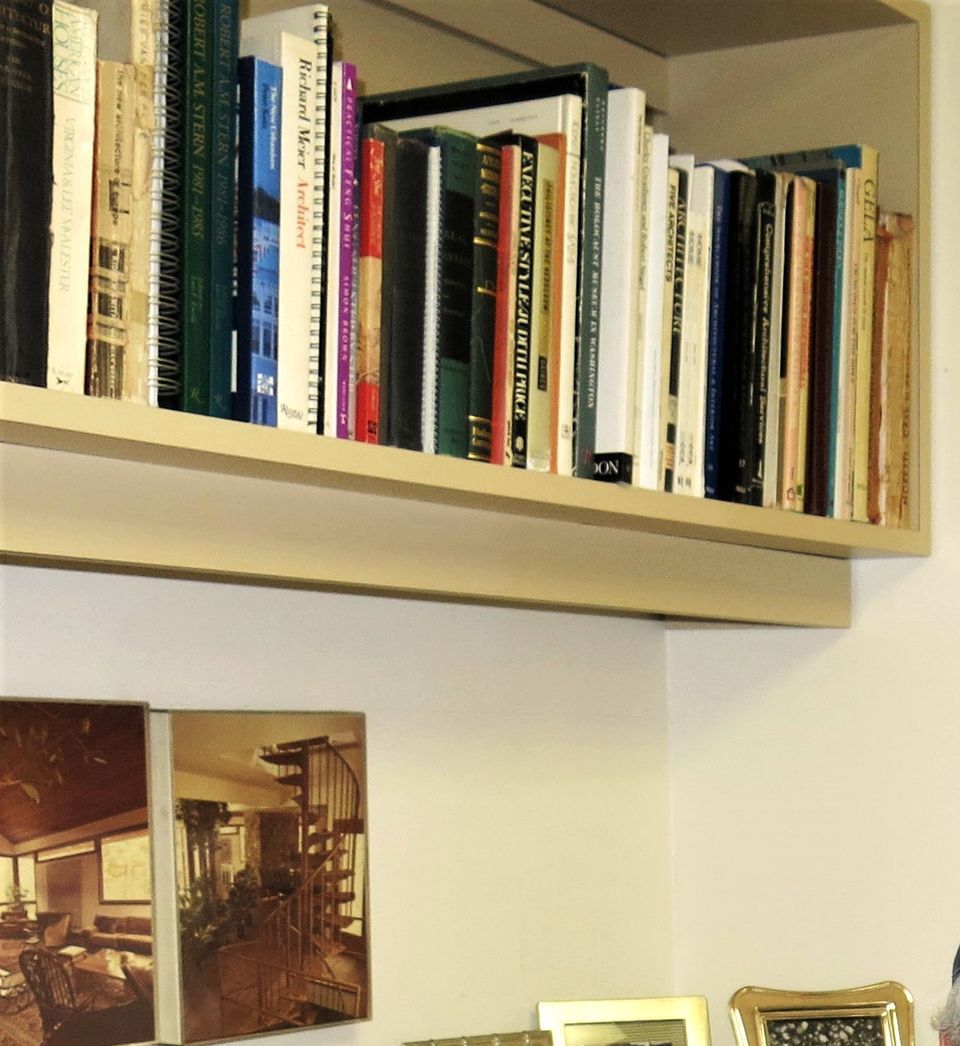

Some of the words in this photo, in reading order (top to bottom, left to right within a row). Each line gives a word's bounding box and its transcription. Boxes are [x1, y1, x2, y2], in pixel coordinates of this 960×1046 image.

[298, 58, 313, 122] Richard
[192, 104, 206, 156] STERN
[297, 126, 312, 170] Meier
[344, 95, 354, 163] PRACTICAL
[296, 179, 310, 249] Architect
[343, 168, 353, 207] FENG
[519, 151, 535, 248] EXECUTIVE
[593, 176, 602, 199] THE
[668, 184, 678, 209] FIVE
[862, 179, 878, 242] GELA
[343, 211, 352, 249] SHUI
[591, 202, 602, 266] HOLOCAUST
[664, 210, 676, 283] ARCHITECTS
[342, 275, 351, 314] SIMON
[589, 270, 600, 318] MUSEUM
[762, 223, 774, 313] Comprehensive
[586, 336, 598, 409] WASHINGTON
[759, 315, 771, 393] Architectural
[513, 372, 528, 421] PRICE
[757, 395, 768, 445] Services
